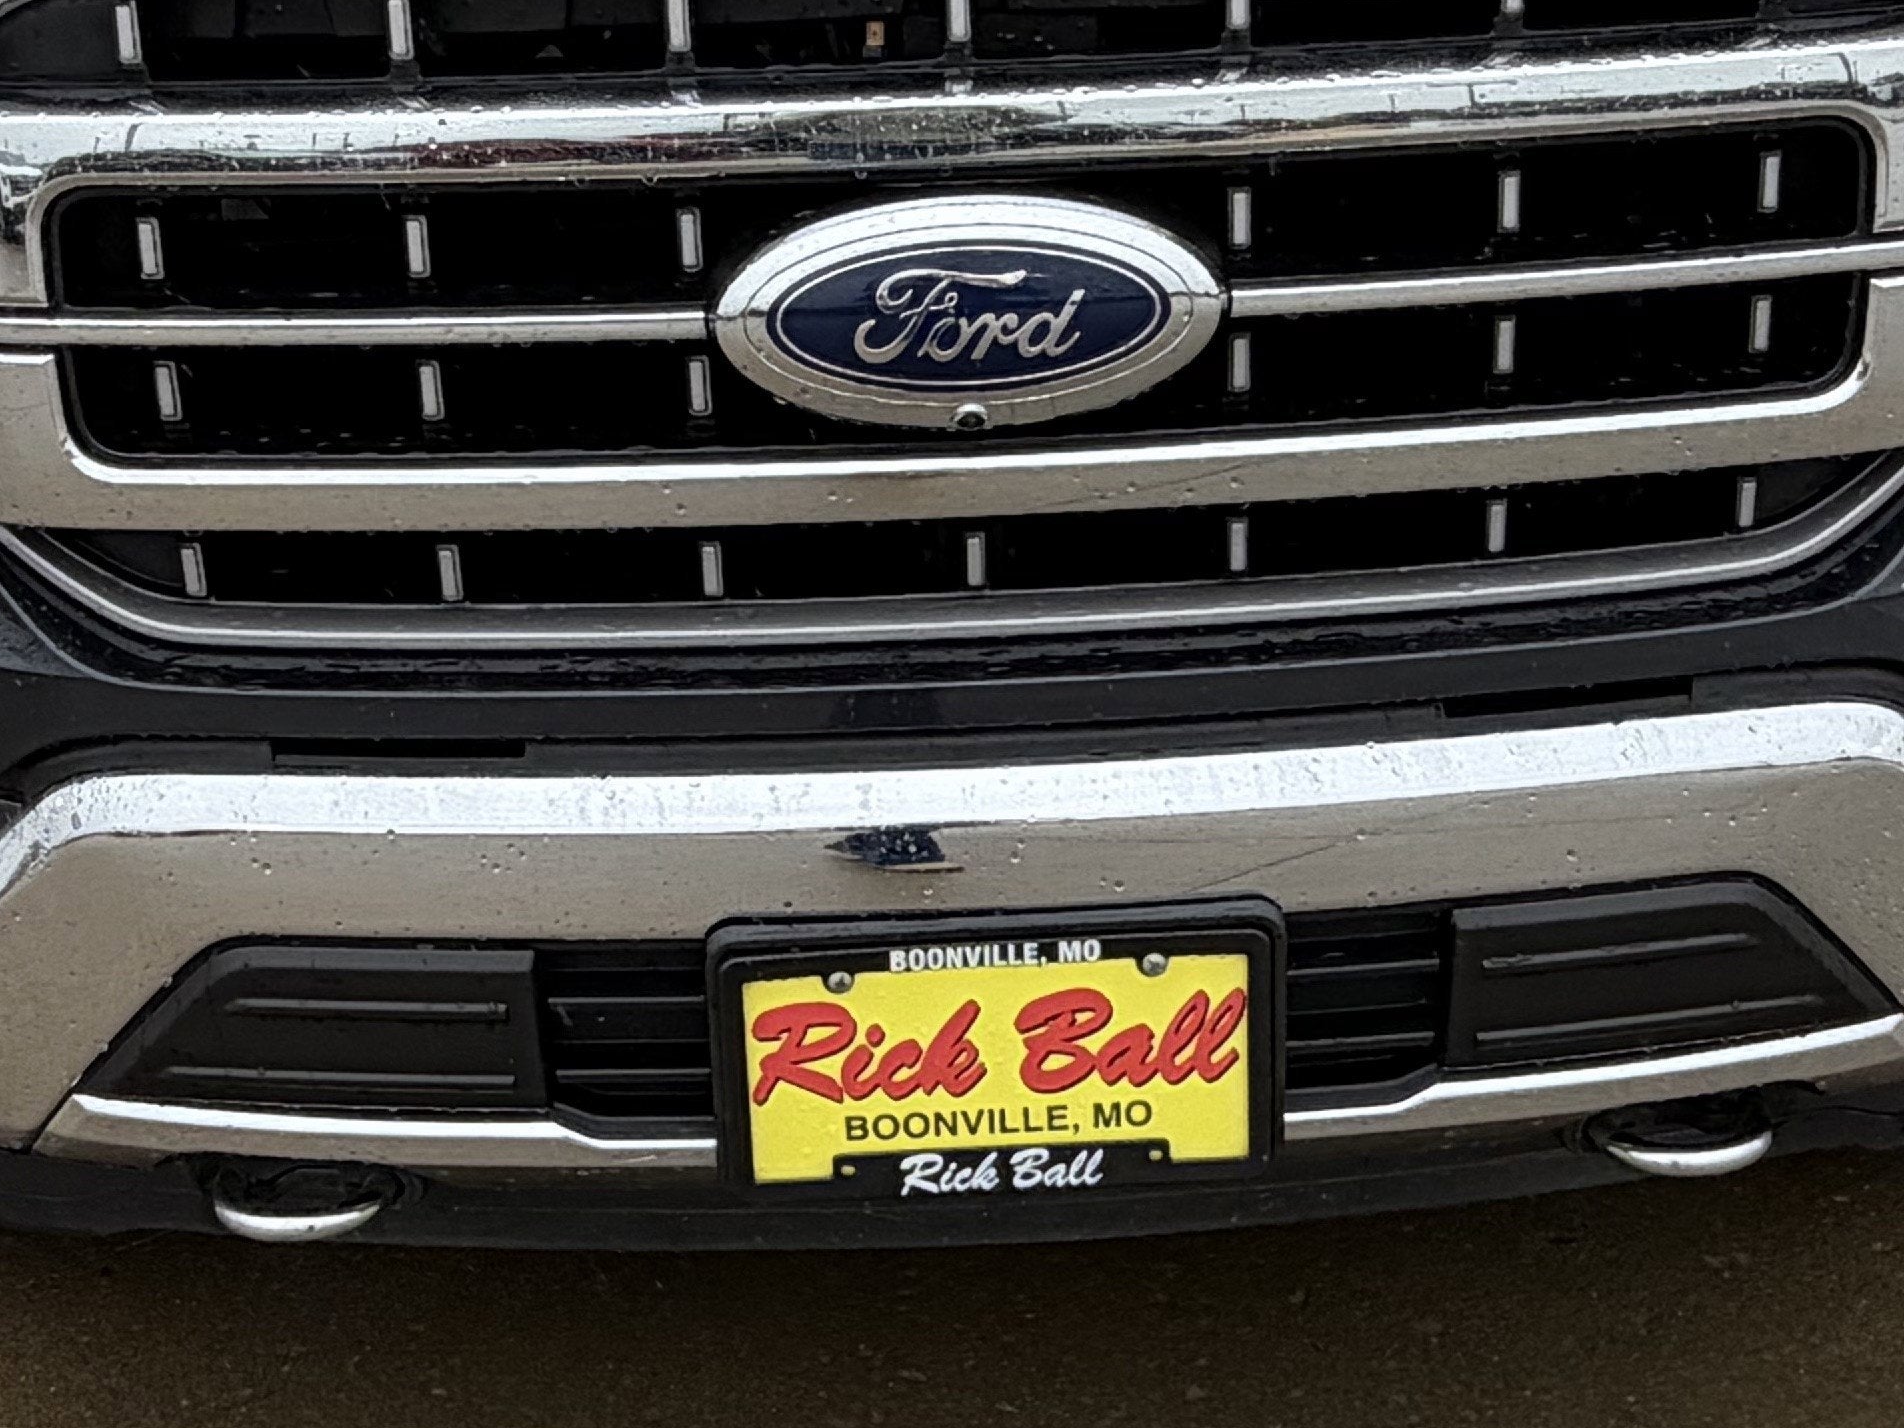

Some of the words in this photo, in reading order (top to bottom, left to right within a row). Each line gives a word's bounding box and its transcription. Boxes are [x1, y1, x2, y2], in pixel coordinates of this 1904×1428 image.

[854, 268, 1086, 364] Ford
[889, 942, 1047, 972] BOONVILLE,
[1058, 939, 1102, 963] MO
[751, 998, 988, 1107] Rick
[1013, 986, 1246, 1094] Ball
[844, 1104, 1080, 1142] BOONVILLE,
[1092, 1099, 1153, 1129] MO
[899, 1151, 1000, 1197] Rick
[1009, 1147, 1104, 1191] Ball
